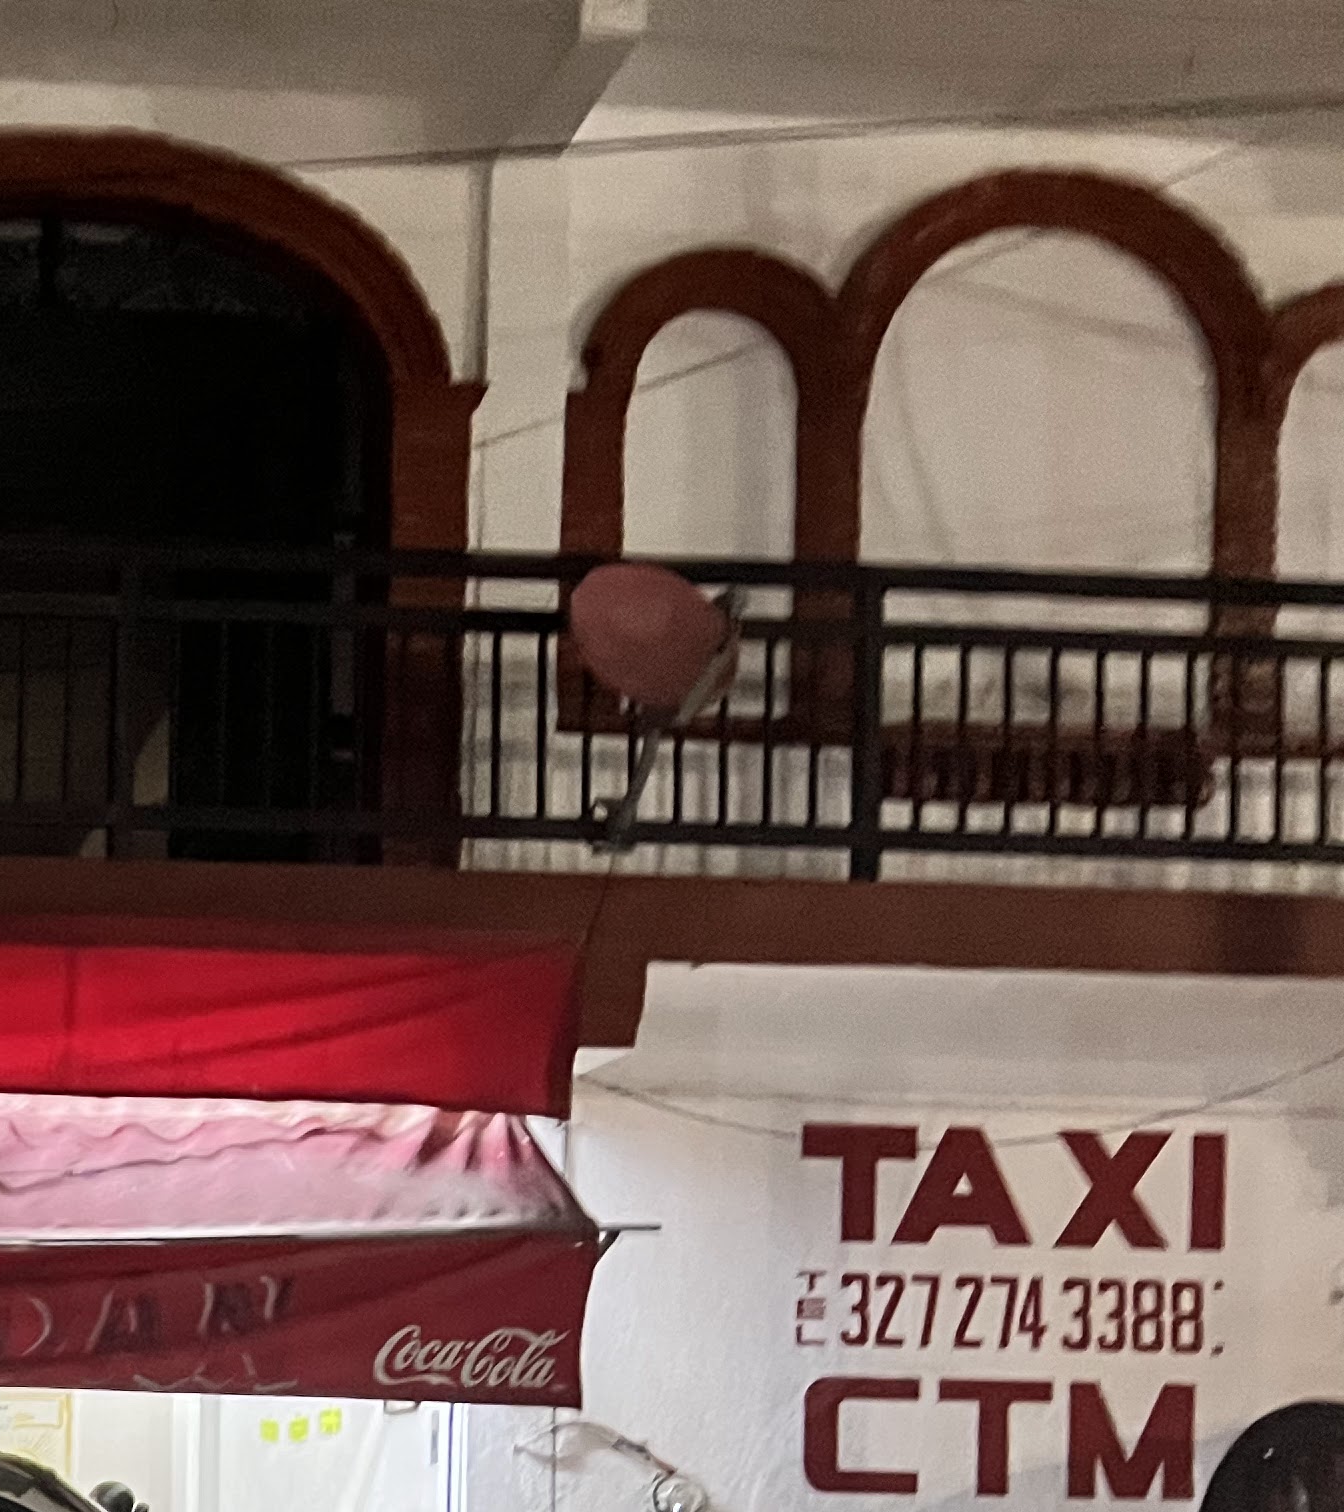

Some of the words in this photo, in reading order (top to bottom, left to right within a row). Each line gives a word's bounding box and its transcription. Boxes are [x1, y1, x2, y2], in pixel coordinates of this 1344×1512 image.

[800, 1123, 1228, 1252] TAXI
[373, 1324, 571, 1389] Coca-Cola
[840, 1272, 941, 1349] 327
[953, 1274, 1048, 1350] 274
[802, 1376, 1196, 1501] CTM
